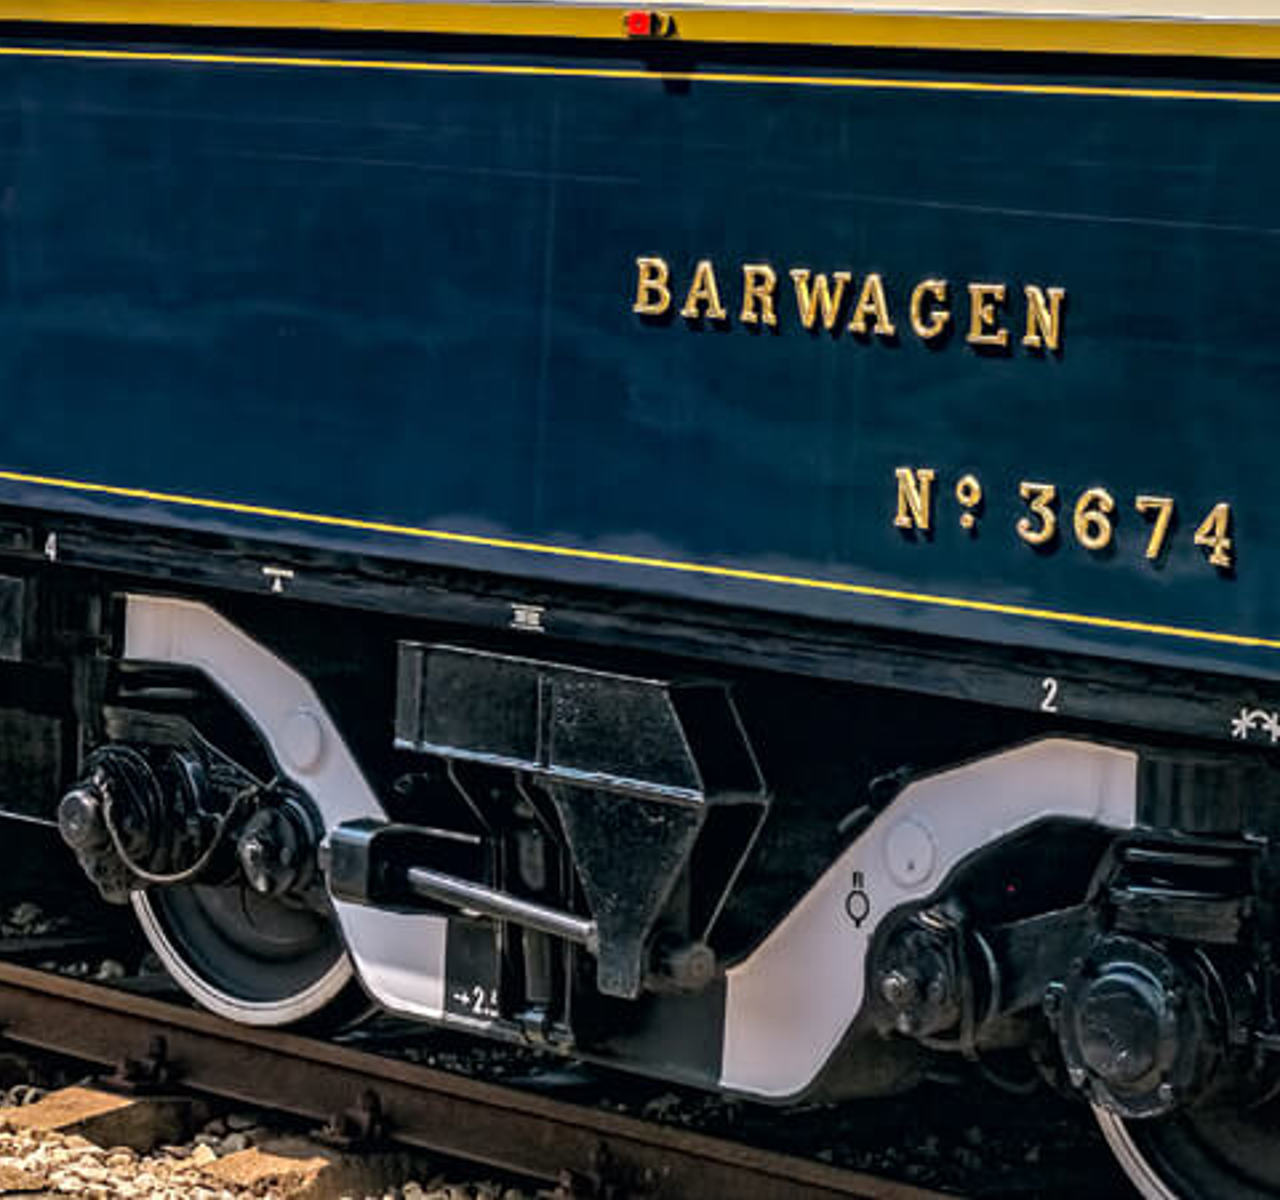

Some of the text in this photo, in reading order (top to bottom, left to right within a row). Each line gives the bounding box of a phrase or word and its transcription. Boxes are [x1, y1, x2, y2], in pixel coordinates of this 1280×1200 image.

[633, 257, 1065, 349] BARWAGEN
[44, 530, 57, 563] 4
[1017, 482, 1231, 567] 3674
[1041, 676, 1059, 714] 2
